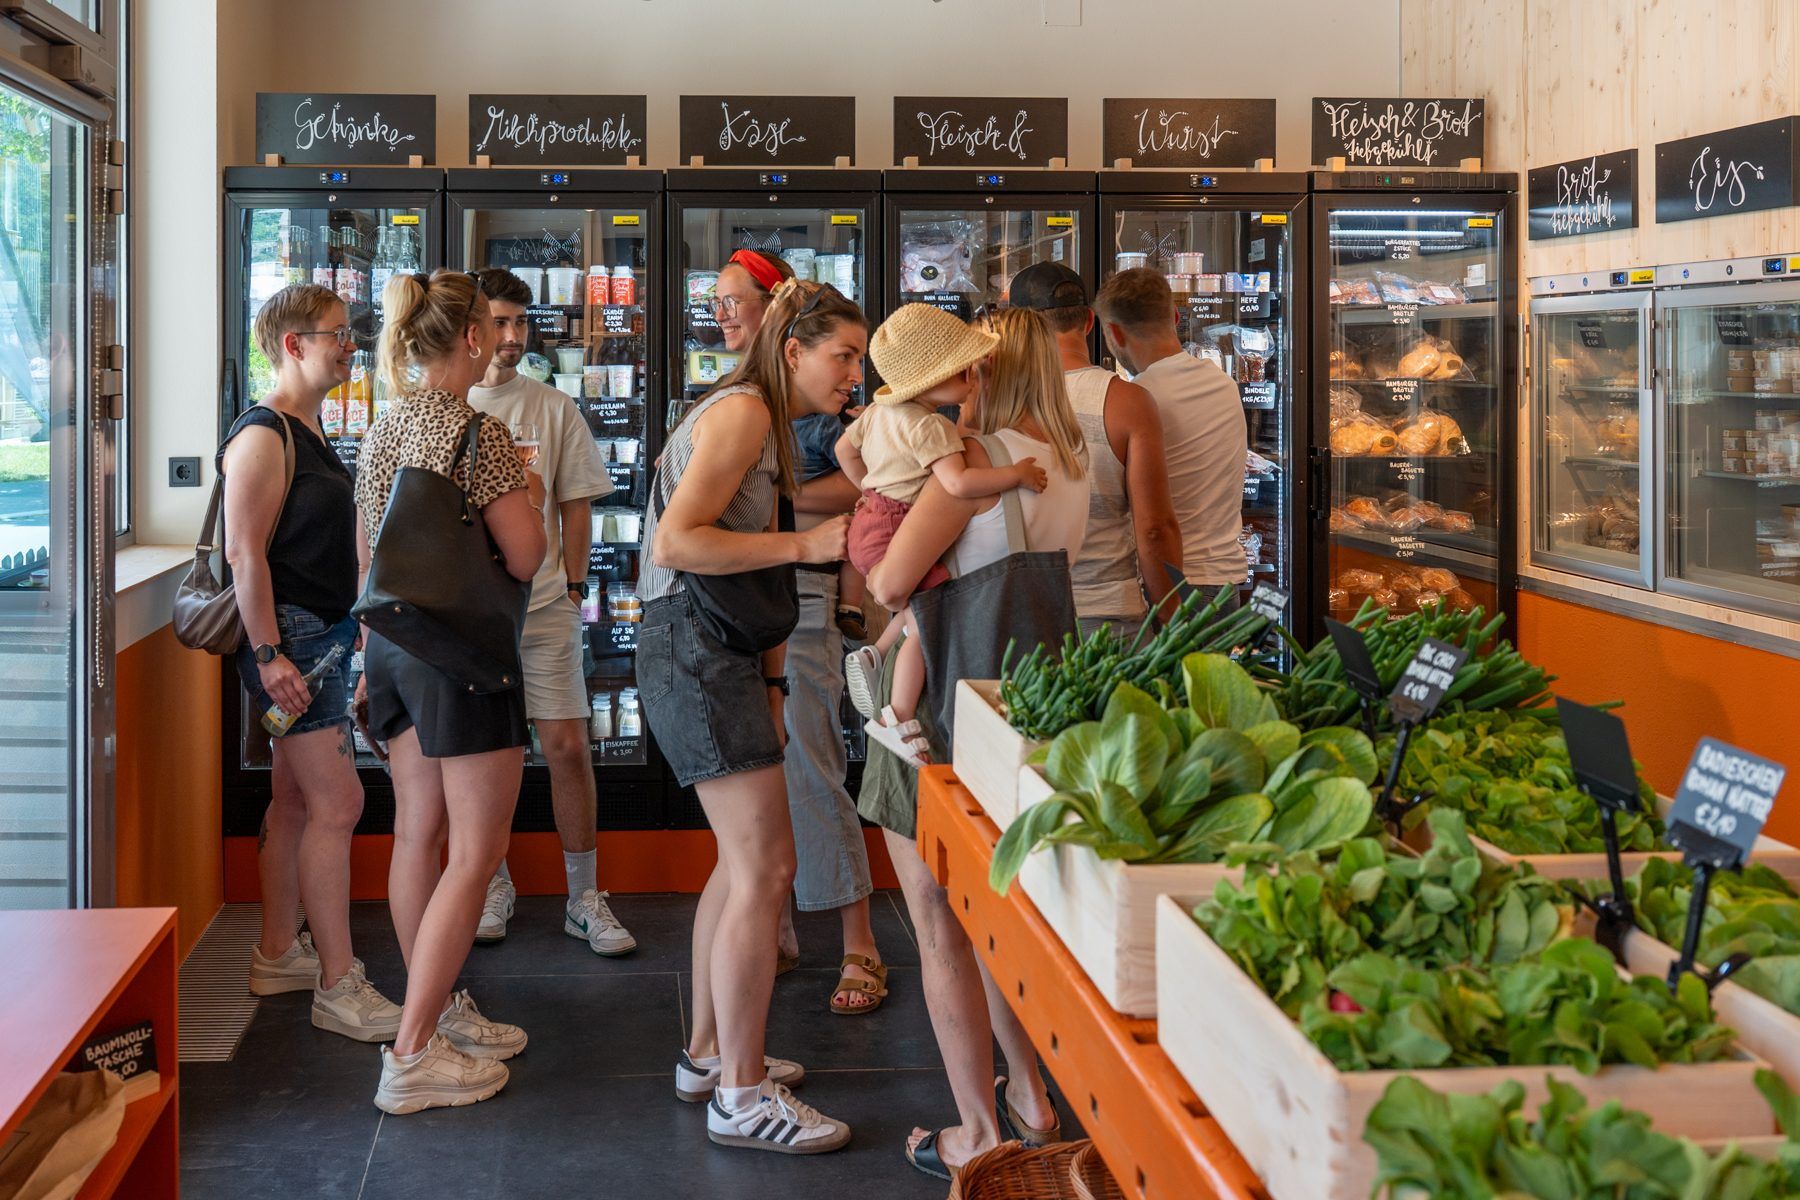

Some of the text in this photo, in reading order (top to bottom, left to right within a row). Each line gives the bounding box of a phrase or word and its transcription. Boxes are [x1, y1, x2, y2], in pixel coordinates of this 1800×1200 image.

[295, 101, 412, 150] Getränke
[477, 105, 642, 153] Milchprodukte
[719, 102, 806, 153] Käse
[918, 111, 1005, 156] Fleisch
[1135, 108, 1238, 157] Wurst
[1325, 101, 1481, 141] Fleisch & Brot
[1557, 157, 1606, 208] Brot
[1689, 147, 1758, 209] Eis
[605, 740, 639, 748] EISKAFFEE
[94, 1042, 144, 1071] TASCHE
